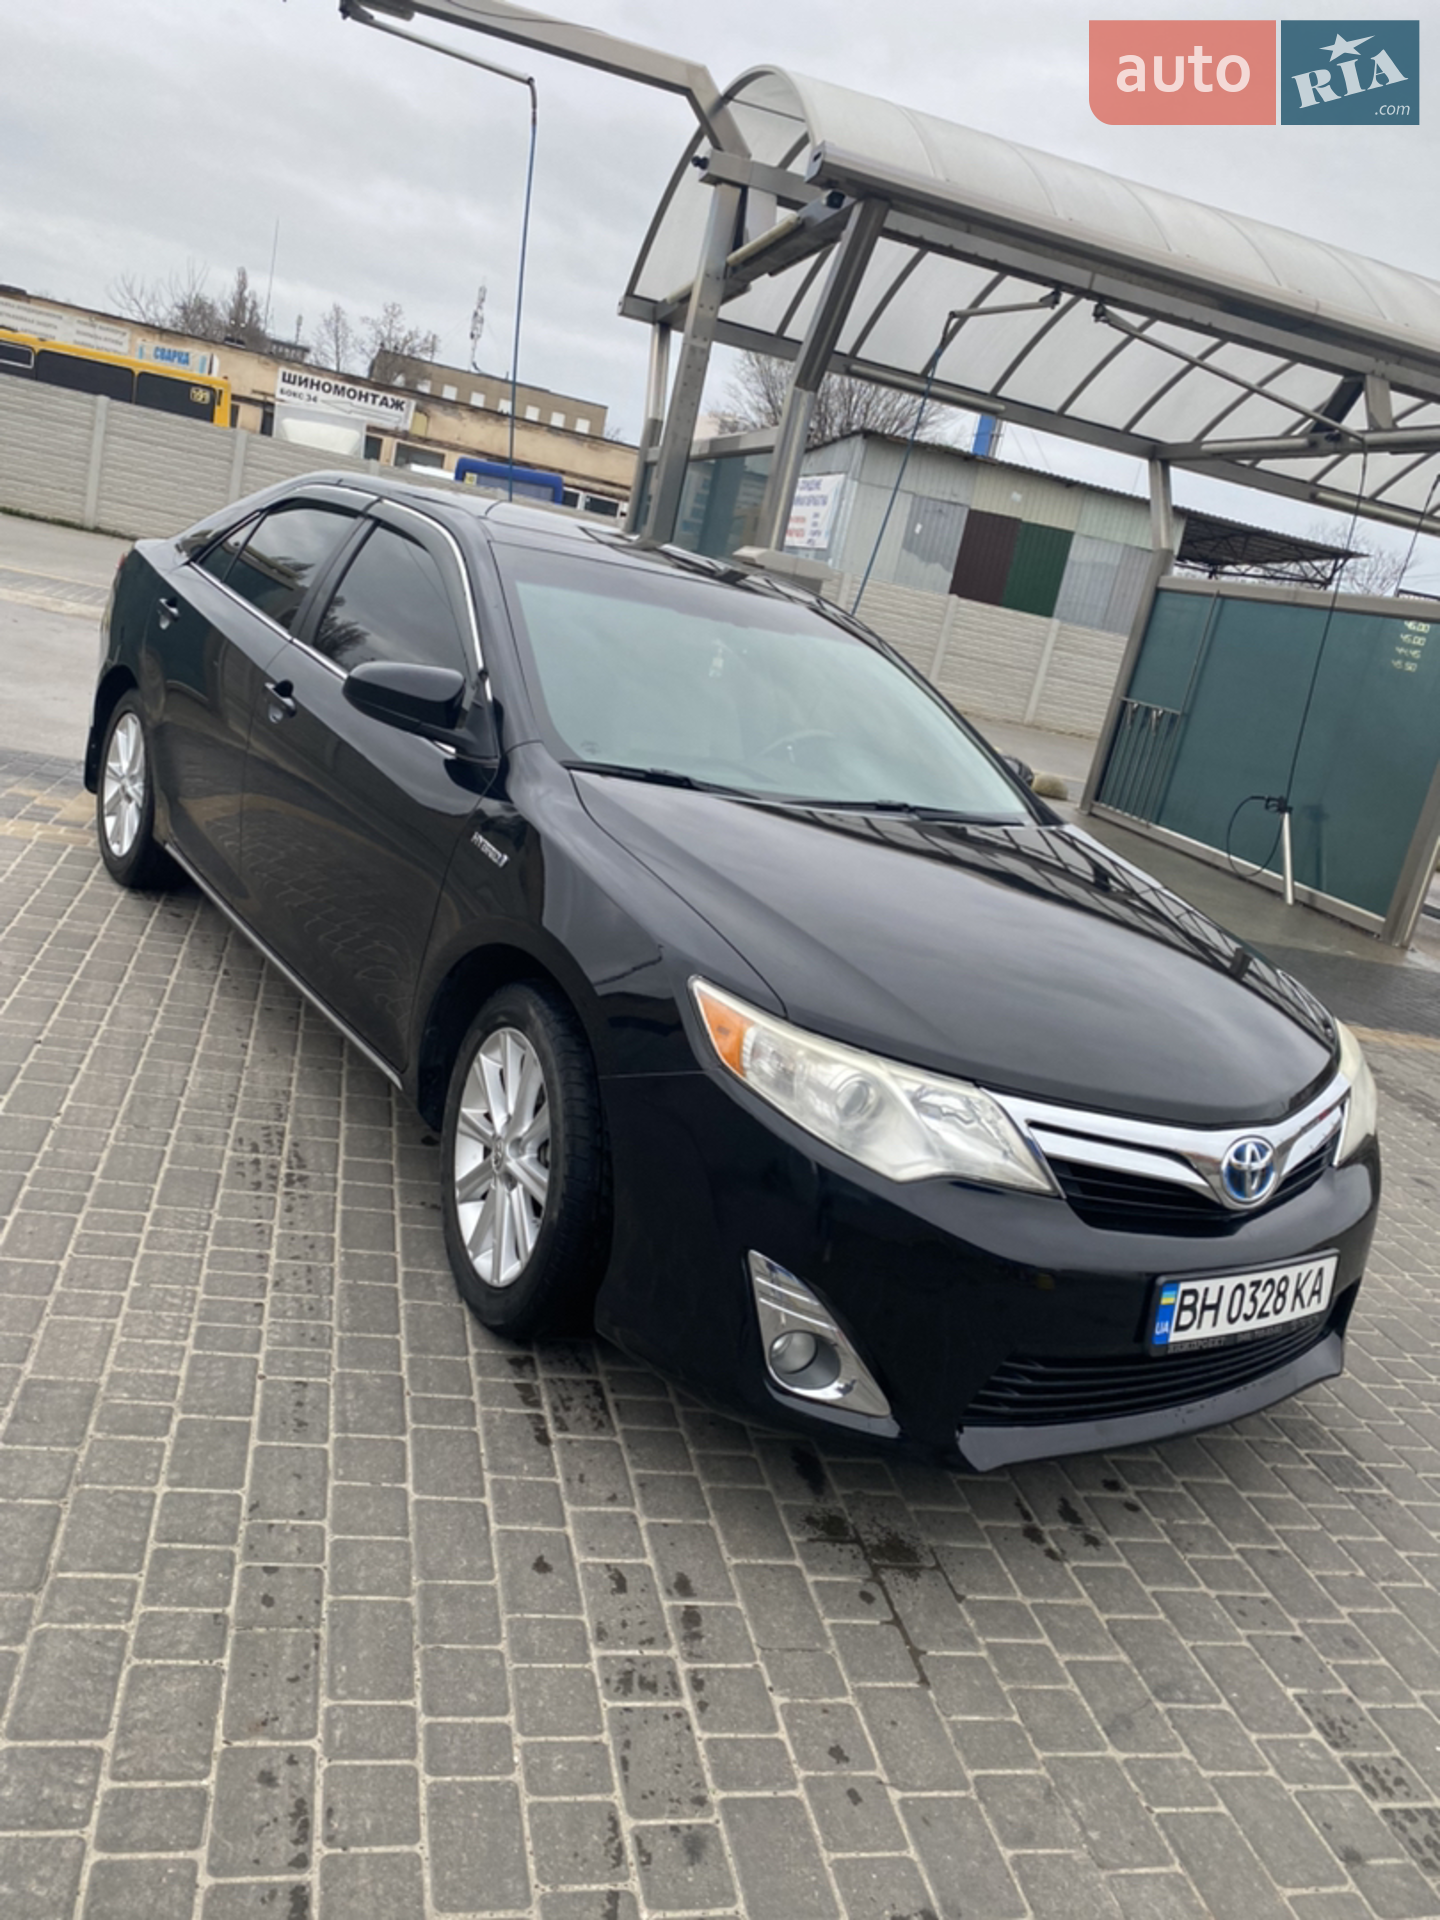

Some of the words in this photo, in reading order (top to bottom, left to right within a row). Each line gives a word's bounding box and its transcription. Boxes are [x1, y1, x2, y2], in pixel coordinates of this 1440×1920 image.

[281, 371, 406, 412] ШИНОМОНТАЖ
[1174, 1285, 1225, 1333] BH
[1226, 1275, 1290, 1325] 0328
[1291, 1267, 1324, 1312] KA
[1155, 1320, 1169, 1335] UA
